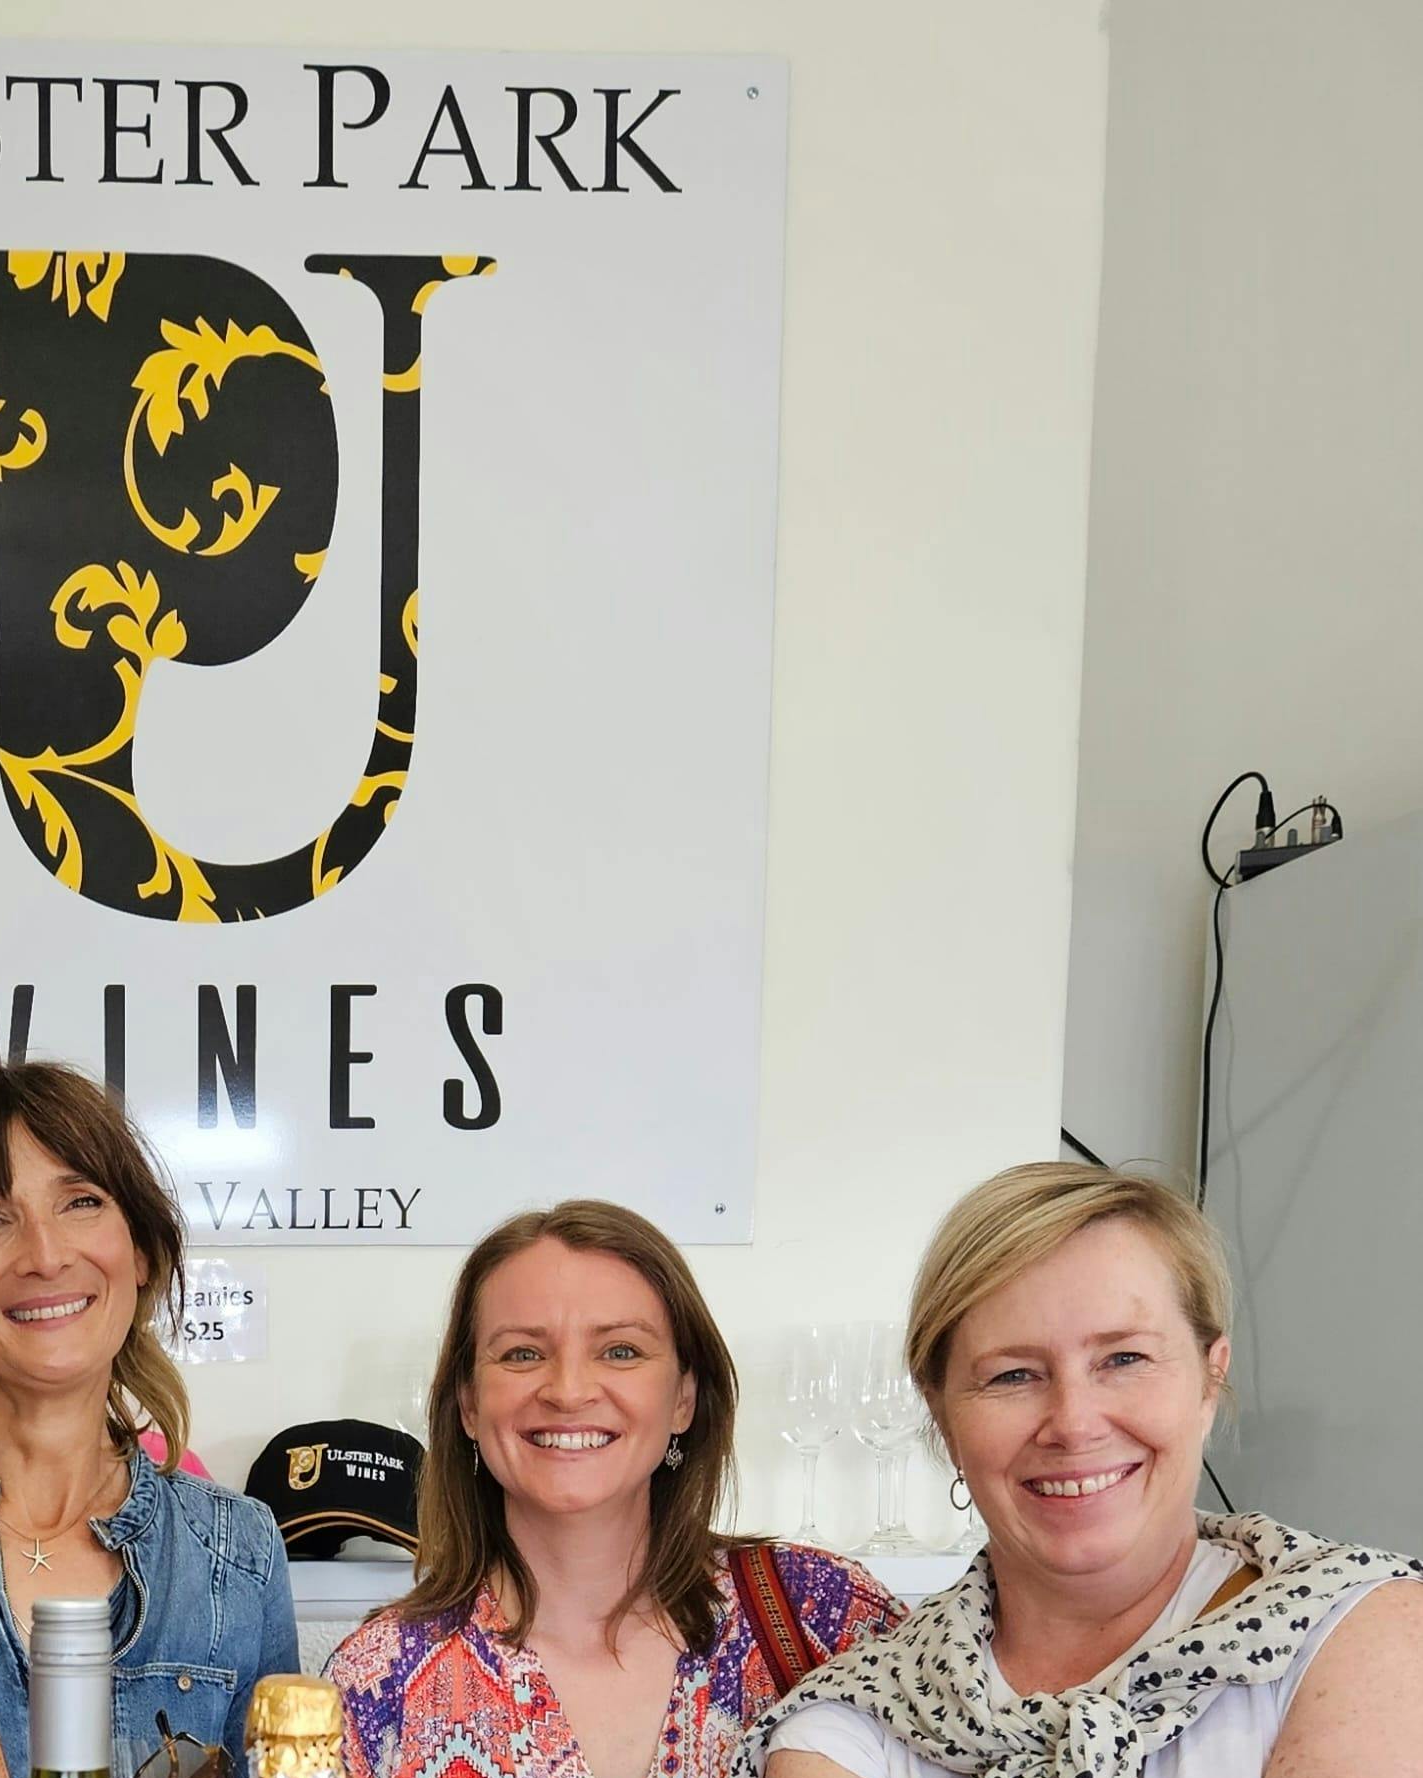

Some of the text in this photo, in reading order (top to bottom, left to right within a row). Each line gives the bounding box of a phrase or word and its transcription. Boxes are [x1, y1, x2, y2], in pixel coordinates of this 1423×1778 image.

[302, 63, 683, 194] PARK
[194, 1181, 422, 1231] VALLEY
[184, 1320, 224, 1344] $25
[327, 1449, 404, 1471] ULSTER PARK
[346, 1464, 386, 1482] WINES
